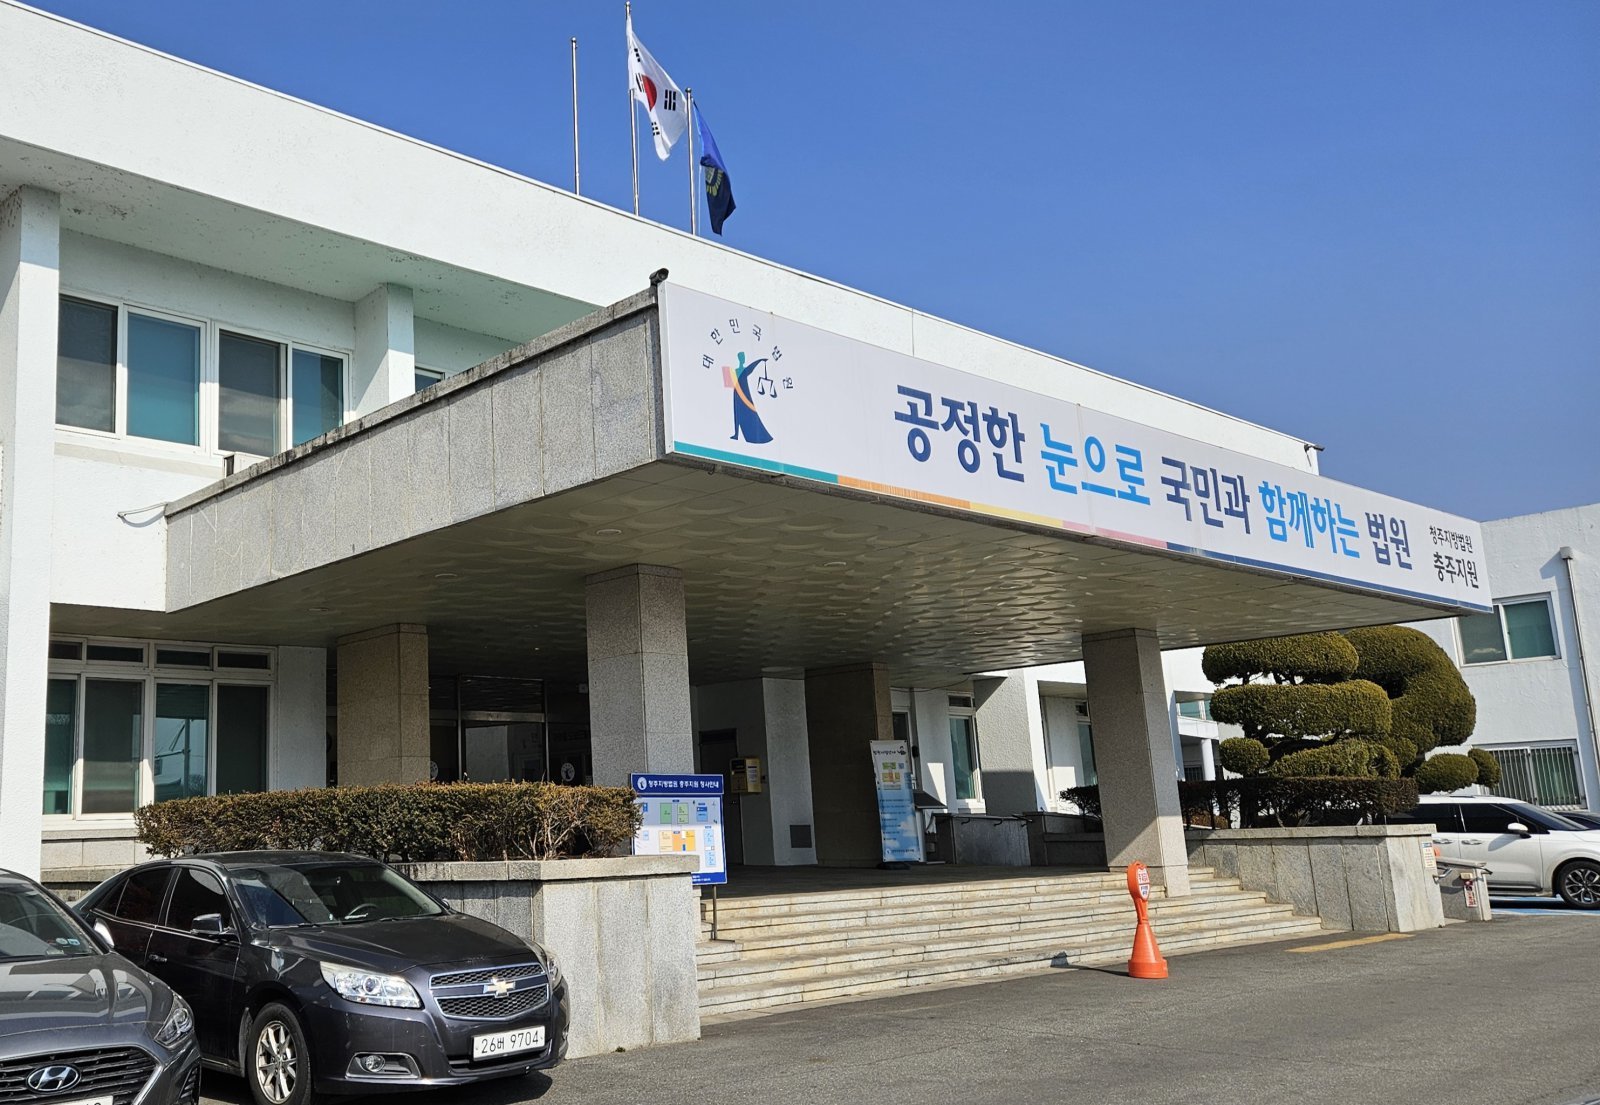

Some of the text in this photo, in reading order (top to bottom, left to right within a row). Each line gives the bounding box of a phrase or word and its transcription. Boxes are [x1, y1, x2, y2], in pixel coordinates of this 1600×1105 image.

[894, 385, 1412, 570] 공정한 눈으로 국민과 함께하는 법원
[1429, 525, 1473, 553] 청주지방법원
[1433, 551, 1479, 589] 충주지원
[481, 1030, 539, 1054] 26버 9704
